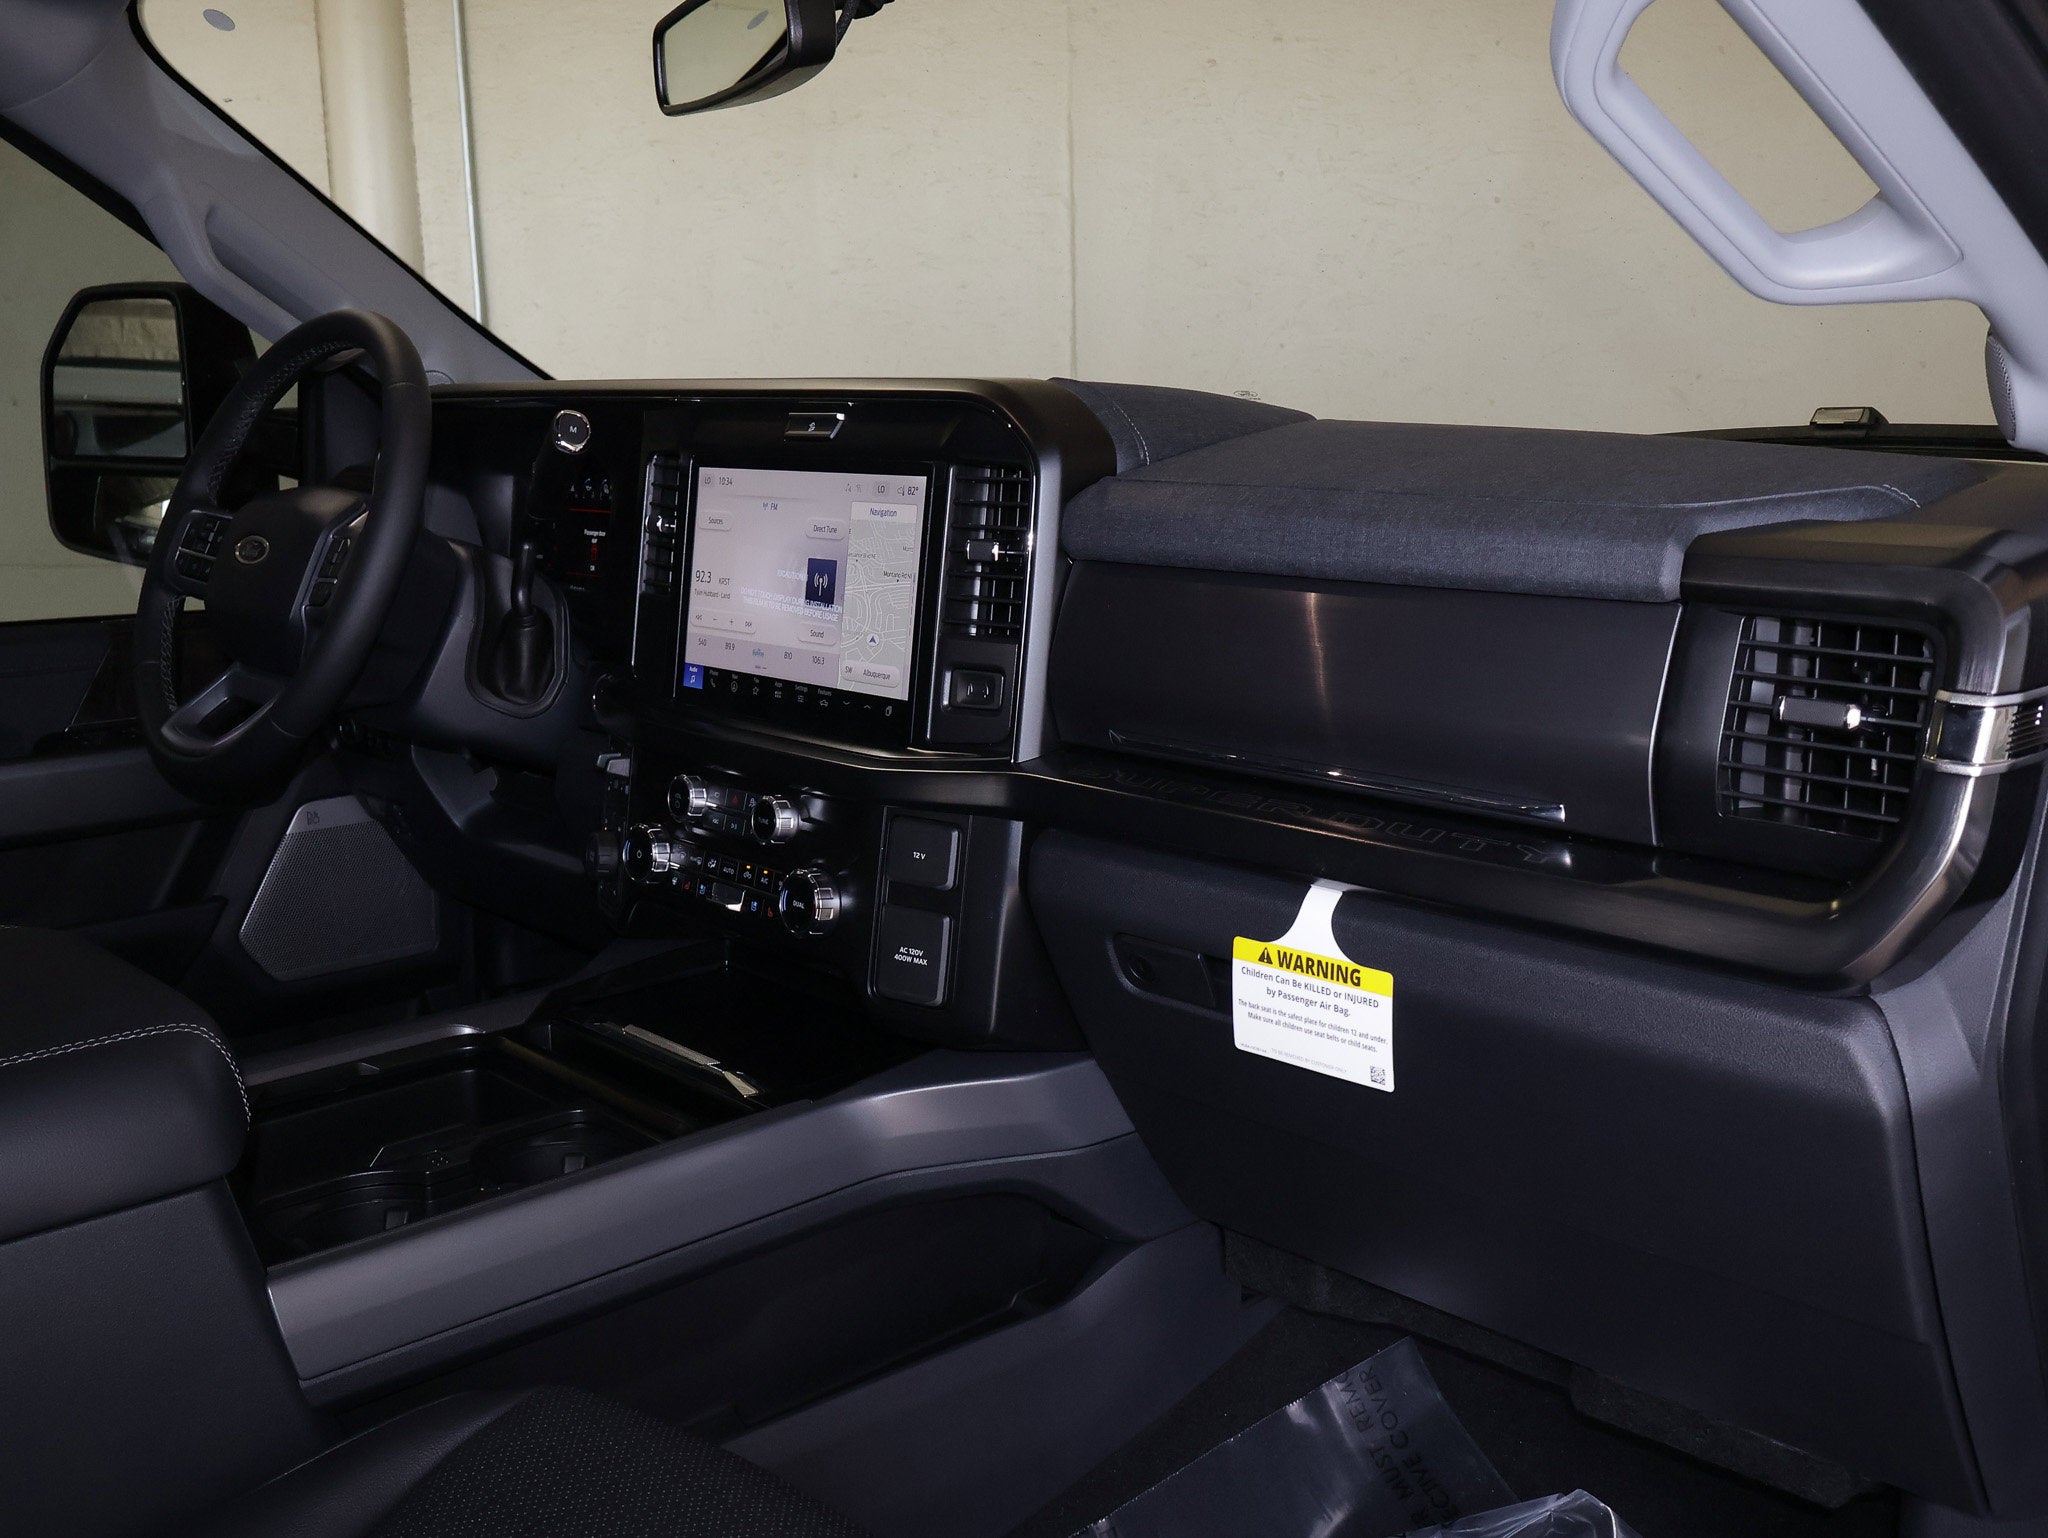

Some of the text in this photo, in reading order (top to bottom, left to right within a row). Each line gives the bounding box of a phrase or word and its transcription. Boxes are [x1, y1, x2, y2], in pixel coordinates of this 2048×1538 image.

[570, 425, 578, 433] M
[704, 476, 712, 485] LO
[718, 476, 734, 486] 10:34
[877, 485, 886, 494] LO
[907, 486, 919, 496] 82°
[770, 502, 778, 511] FM
[869, 507, 898, 518] Navigation
[708, 516, 724, 525] Sources
[813, 525, 838, 534] Direct Tune
[695, 569, 712, 584] 92.3
[809, 600, 843, 614] INSTALLATION
[822, 611, 839, 622] USAGE
[809, 629, 824, 639] Sound
[863, 668, 891, 680] Albuquerque
[1327, 811, 1560, 864] DUTY
[723, 866, 735, 875] AUTO
[900, 946, 924, 957] AC 120V
[894, 954, 928, 967] 400W MAX
[1277, 949, 1362, 987] WARNING
[1241, 966, 1379, 1009] Children Can Be KILLED or INJURED
[1266, 986, 1351, 1018] by Passenger Air Bag.
[1238, 998, 1248, 1007] The
[1248, 1001, 1260, 1010] back
[1261, 1005, 1272, 1014] seat
[1278, 1010, 1287, 1018] the
[1287, 1013, 1304, 1023] safest
[1304, 1017, 1318, 1026] place
[1318, 1020, 1327, 1029] for
[1327, 1023, 1350, 1035] children
[1350, 1028, 1357, 1037] 12
[1358, 1032, 1369, 1041] and
[1247, 1011, 1262, 1021] Make
[1262, 1017, 1274, 1025] sure
[1282, 1021, 1303, 1033] children
[1303, 1027, 1313, 1036] use
[1314, 1029, 1326, 1039] seat
[1326, 1032, 1340, 1043] belts
[1347, 1039, 1361, 1049] child
[1361, 1043, 1378, 1053] seats.
[1358, 1366, 1409, 1449] COVER
[1366, 1446, 1415, 1501] MUST
